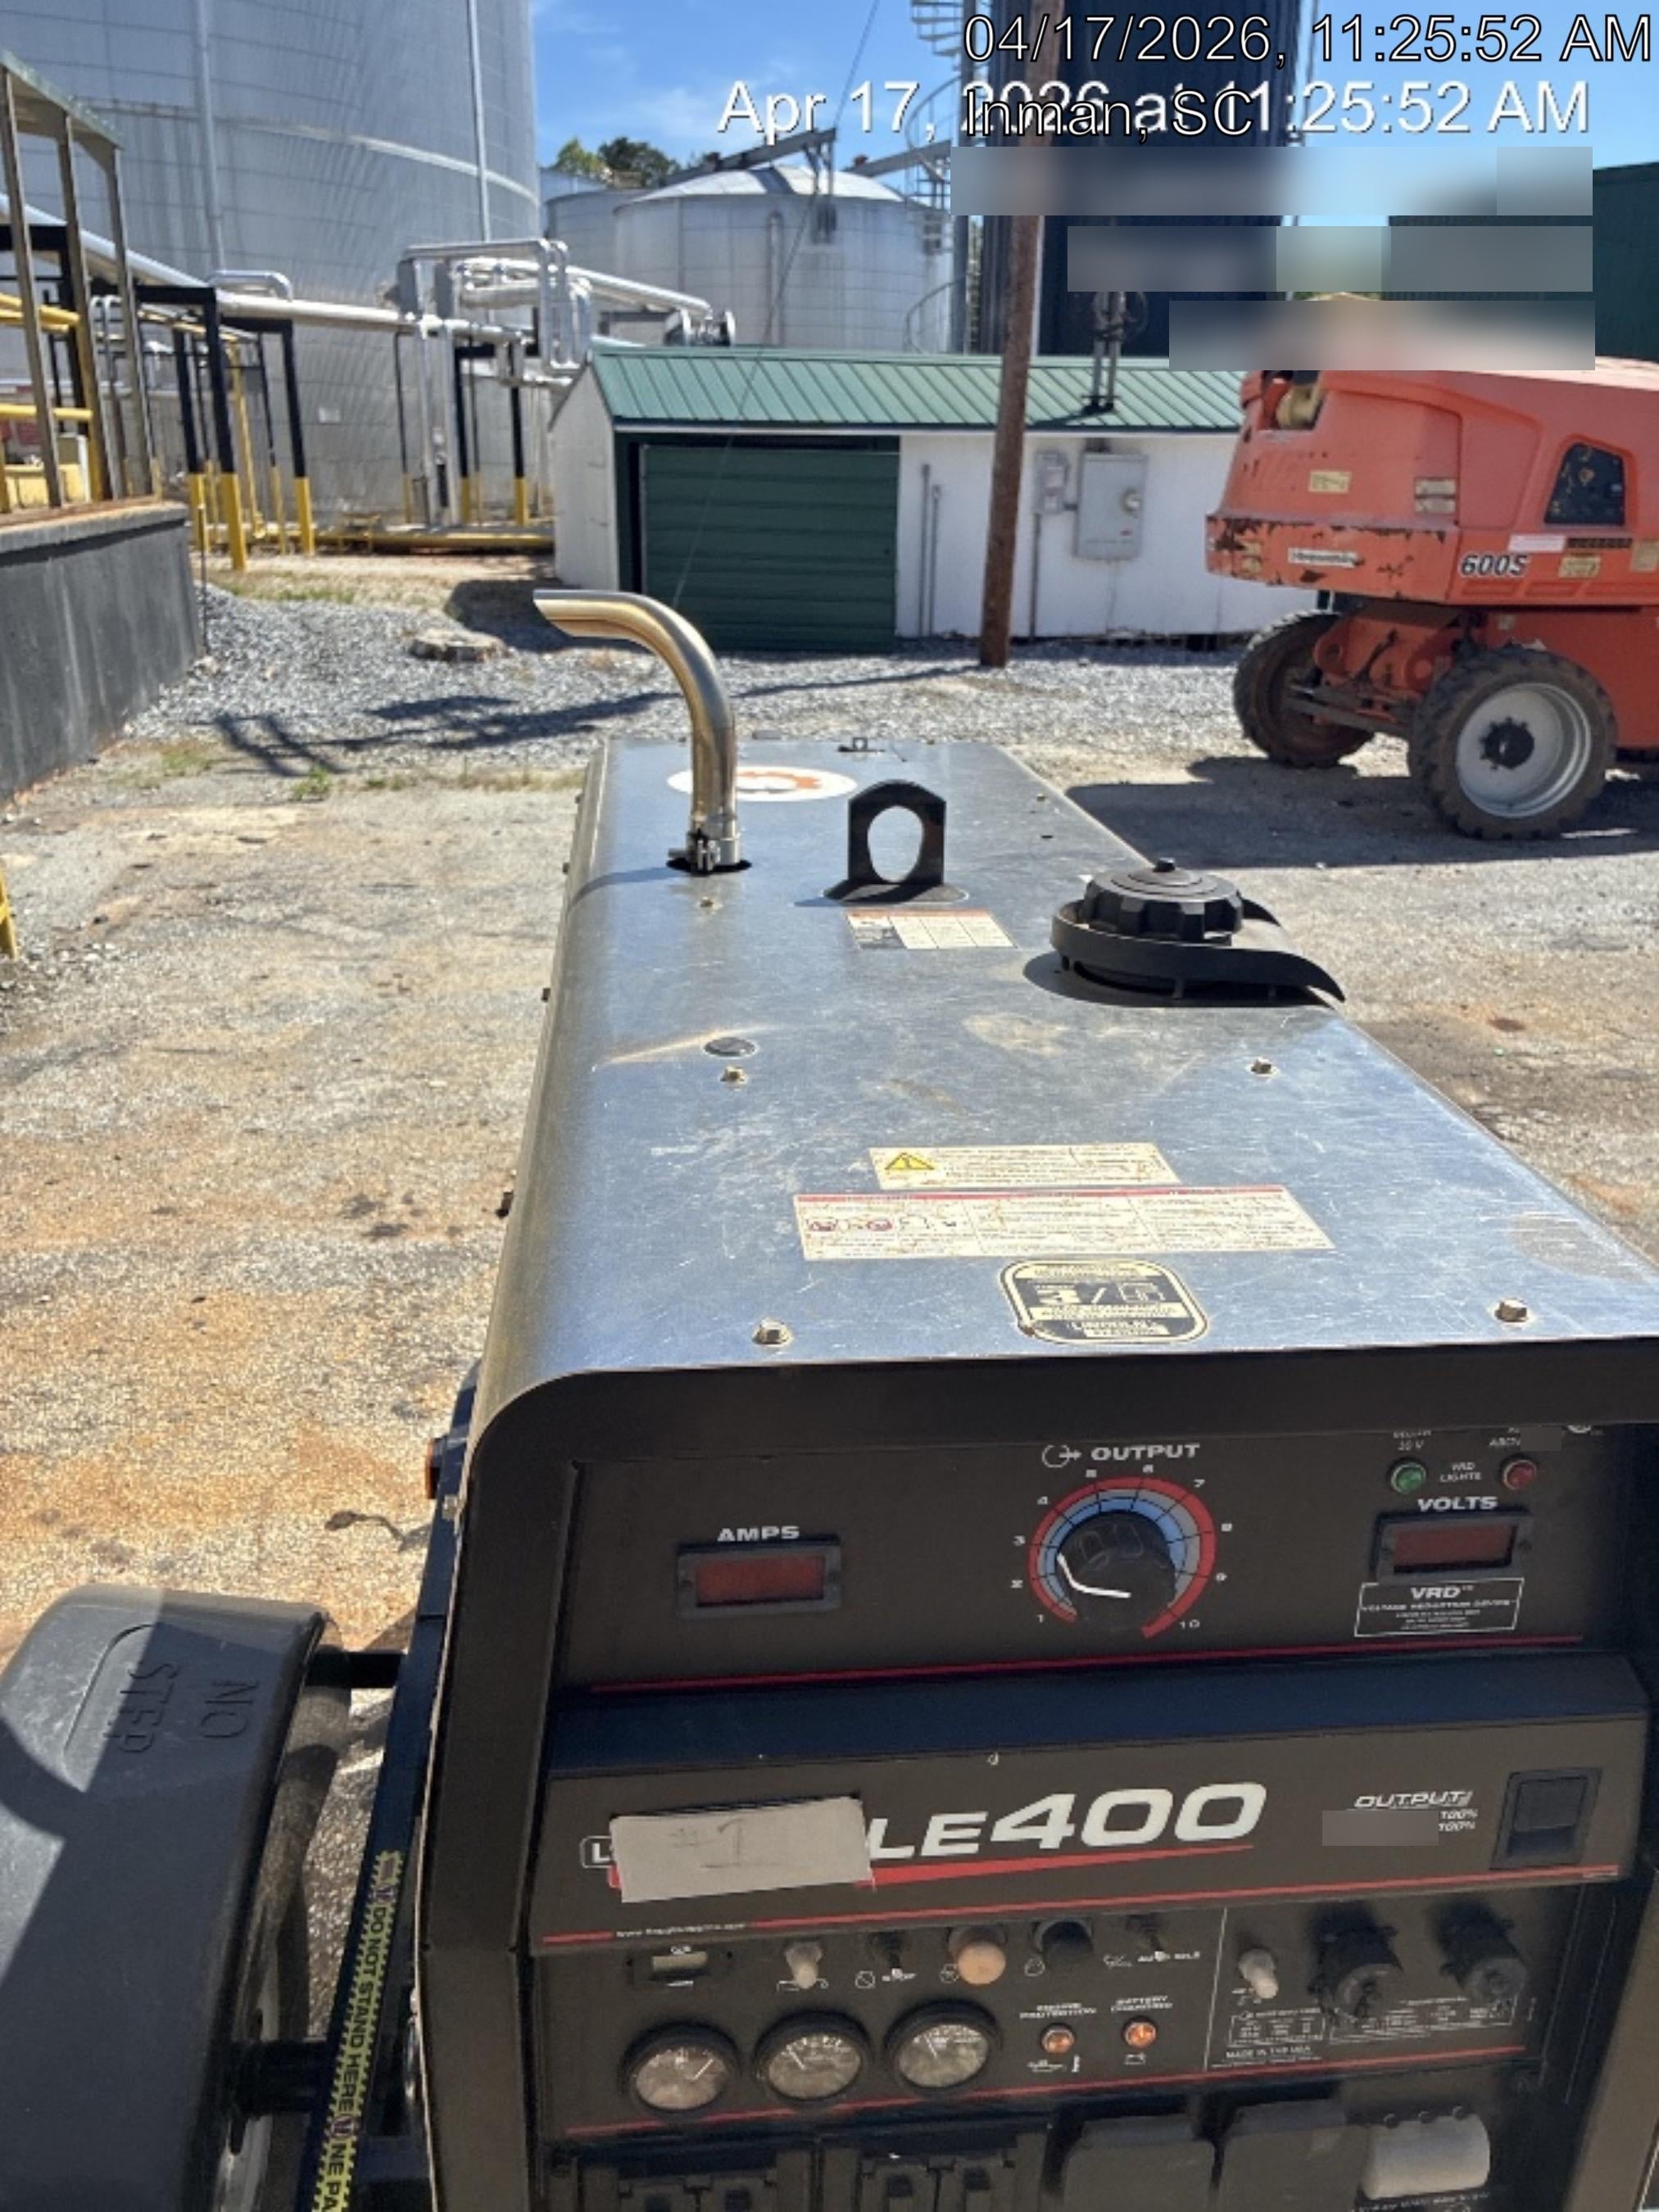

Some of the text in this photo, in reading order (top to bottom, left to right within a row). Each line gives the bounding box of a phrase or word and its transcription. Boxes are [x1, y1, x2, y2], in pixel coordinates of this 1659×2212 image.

[1460, 553, 1529, 578] 600S
[1090, 1444, 1200, 1461] OUTPUT
[1194, 1478, 1206, 1488] 7
[1417, 1496, 1498, 1512] VOLTS
[717, 1525, 800, 1542] AMPS
[1036, 1615, 1044, 1624] 1
[1180, 1619, 1200, 1629] 10
[200, 1680, 261, 1738] NO
[1354, 1790, 1471, 1808] OUTPUT
[338, 1906, 388, 2113] DO NOT STAND HERE
